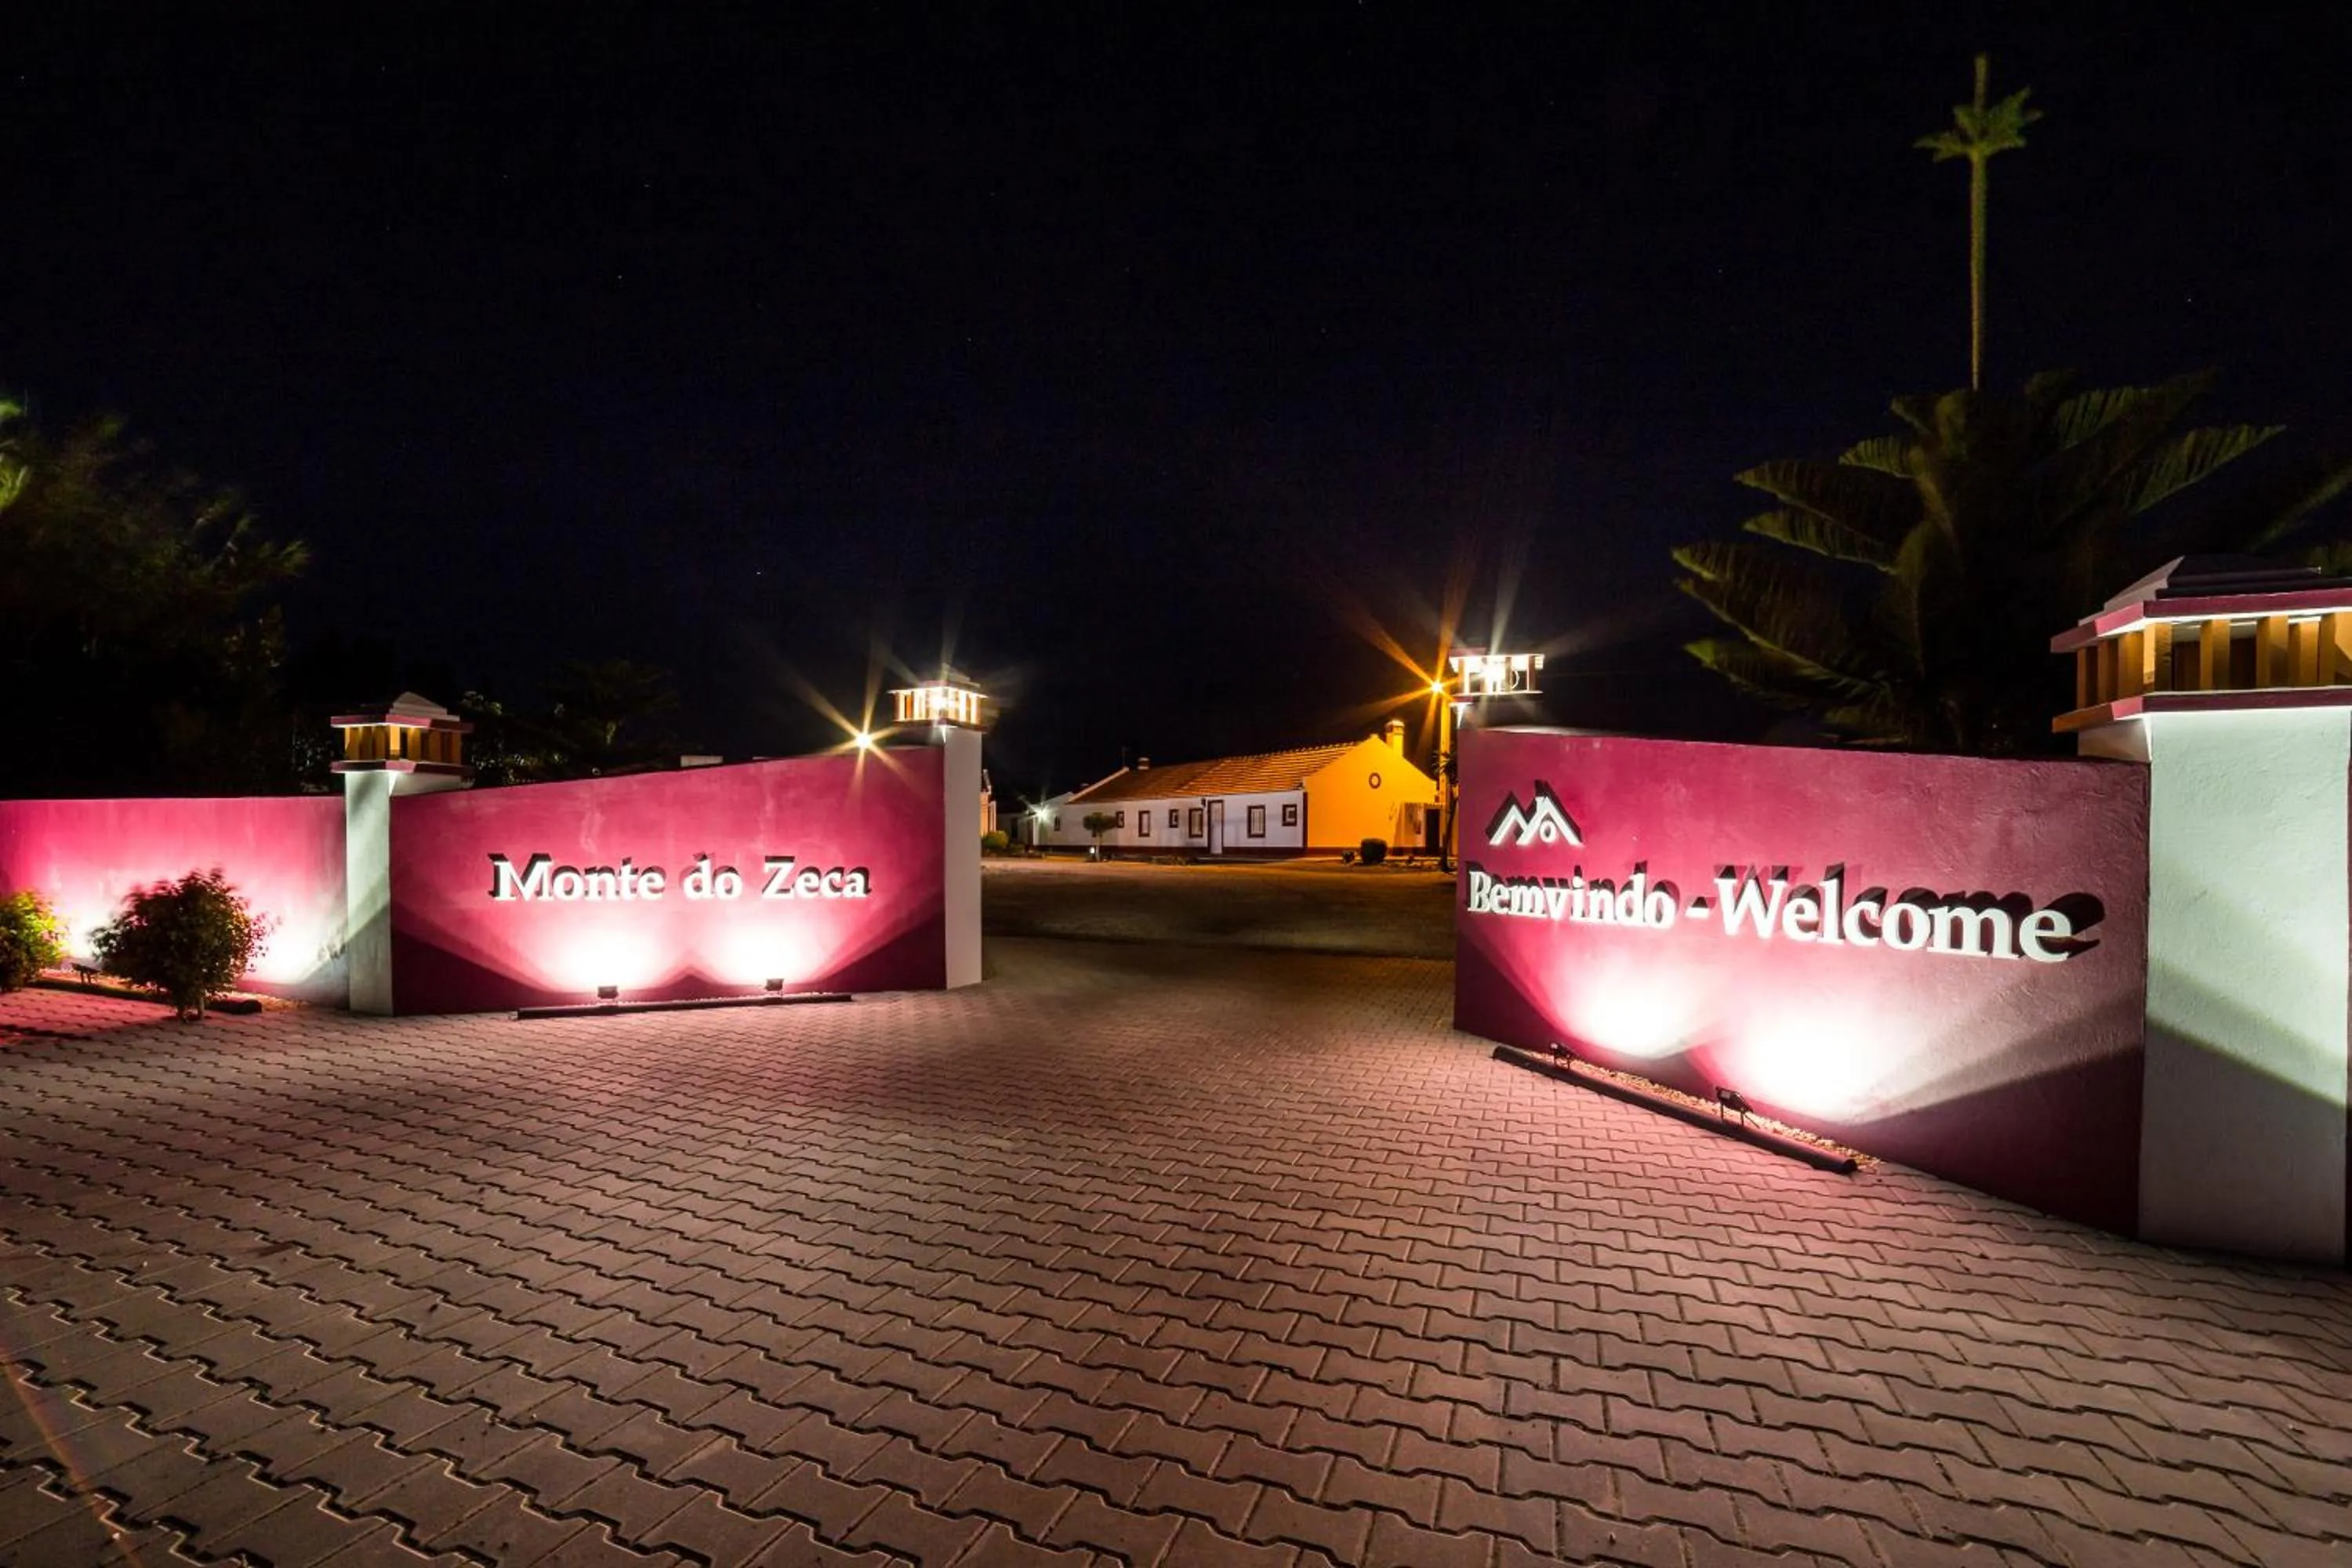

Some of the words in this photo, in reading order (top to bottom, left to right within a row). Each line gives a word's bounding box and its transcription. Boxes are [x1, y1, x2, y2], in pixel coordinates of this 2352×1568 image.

[493, 859, 666, 901] Monte
[683, 859, 743, 900] do
[761, 861, 869, 900] Zeca
[1468, 871, 1677, 930] Bemvindo
[1714, 877, 2072, 963] Welcome
